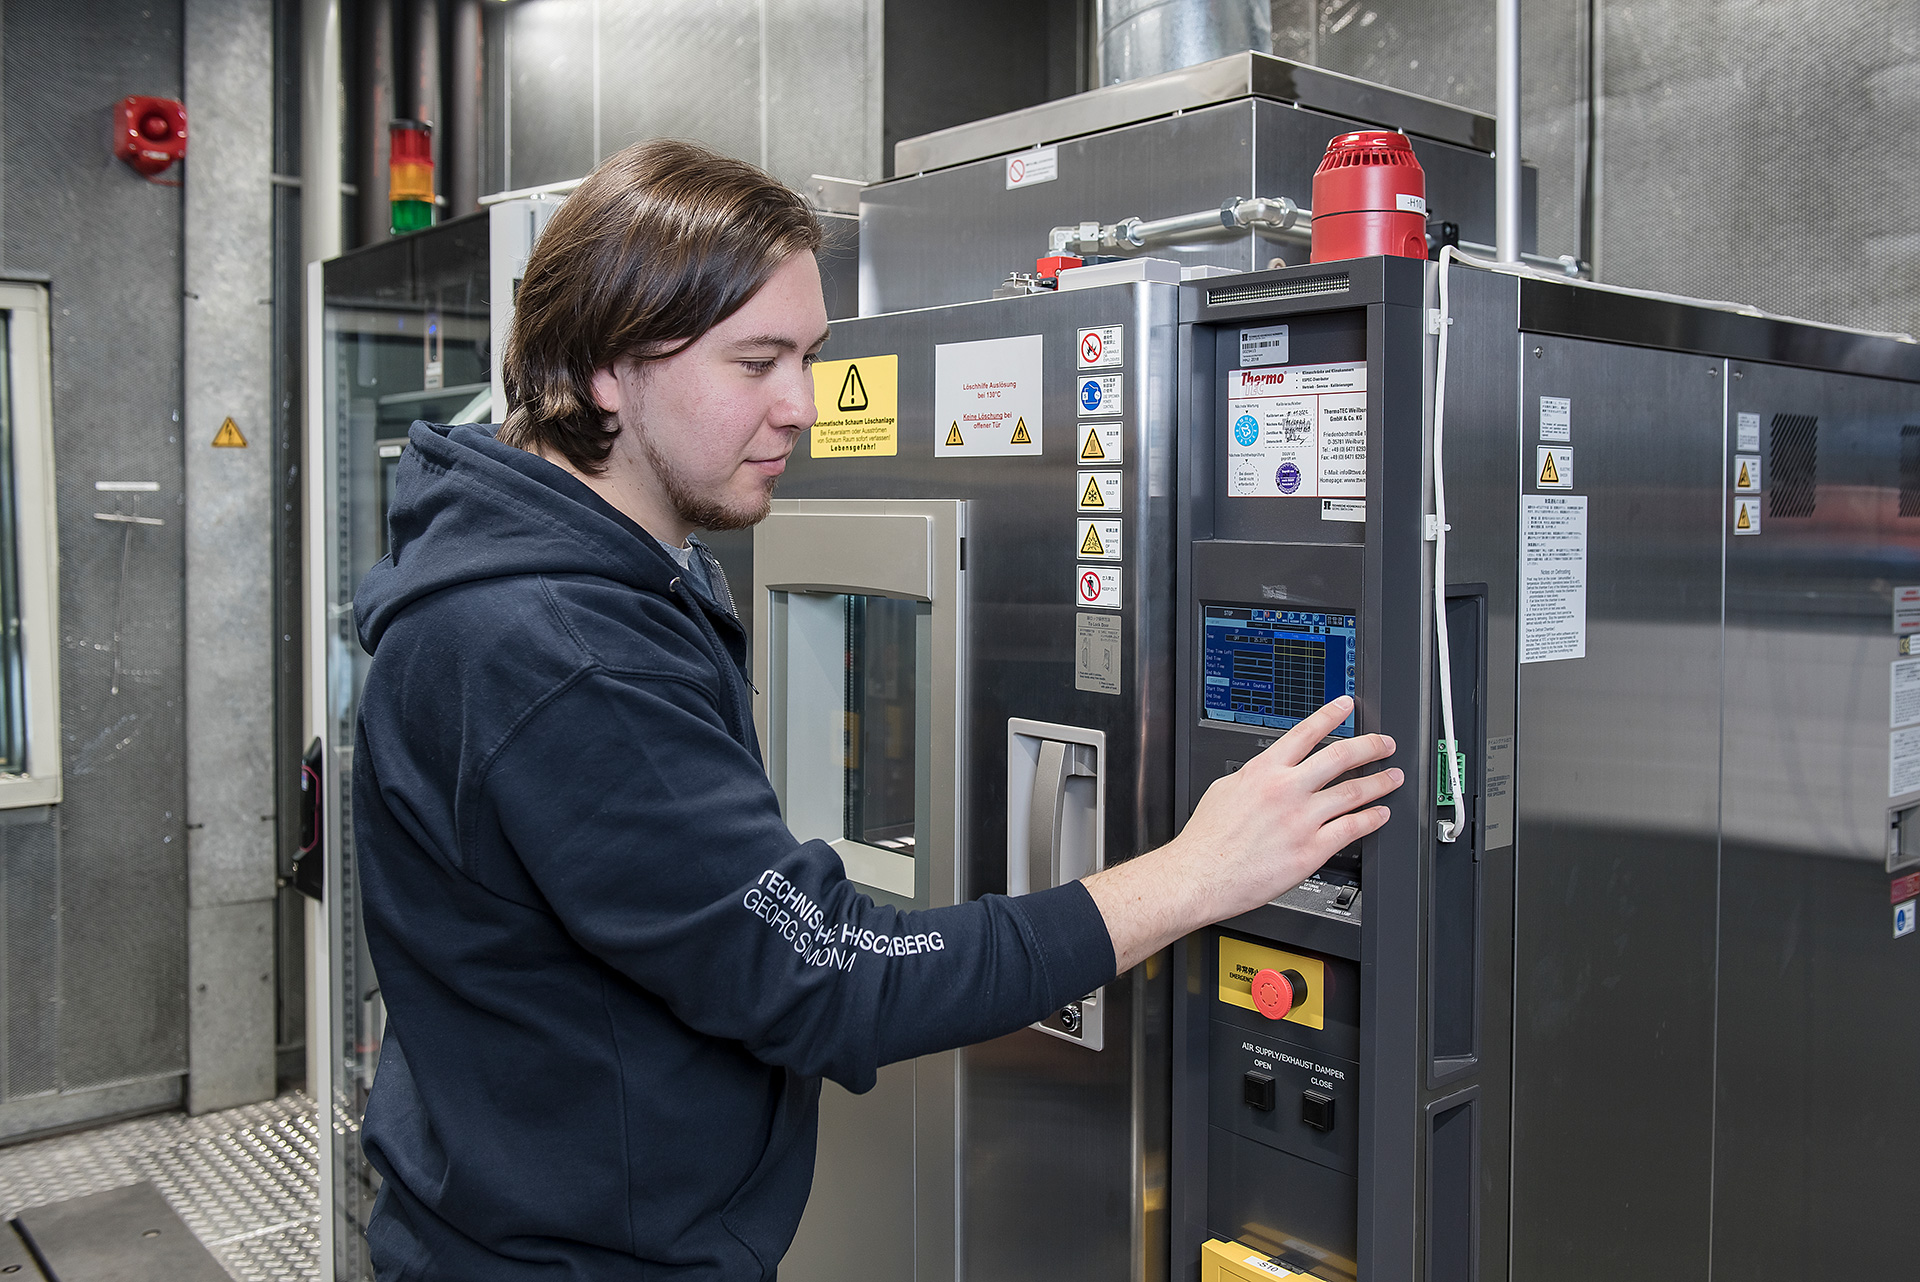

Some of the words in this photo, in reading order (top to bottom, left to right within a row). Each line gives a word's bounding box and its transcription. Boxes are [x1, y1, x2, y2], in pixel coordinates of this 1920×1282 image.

[1407, 198, 1423, 209] -H10
[1241, 371, 1285, 386] Thermo
[963, 382, 988, 391] Löschhilfe
[989, 380, 1017, 389] Auslösung
[986, 390, 1001, 398] 130°C
[845, 418, 863, 426] Schaum
[864, 416, 895, 426] Löschanlage
[963, 413, 977, 421] Keine
[977, 412, 1003, 420] Löschung
[827, 428, 851, 436] Feueralarm
[830, 443, 876, 452] Lebensgefahr!
[743, 888, 799, 943] GEORG
[1241, 1042, 1254, 1052] AIR
[1255, 1045, 1314, 1070] SUPPLY/EXHAUST
[1315, 1063, 1345, 1080] DAMPER
[1254, 1059, 1272, 1070] OPEN
[1310, 1077, 1334, 1090] CLOSE
[1256, 1260, 1279, 1273] -S10
